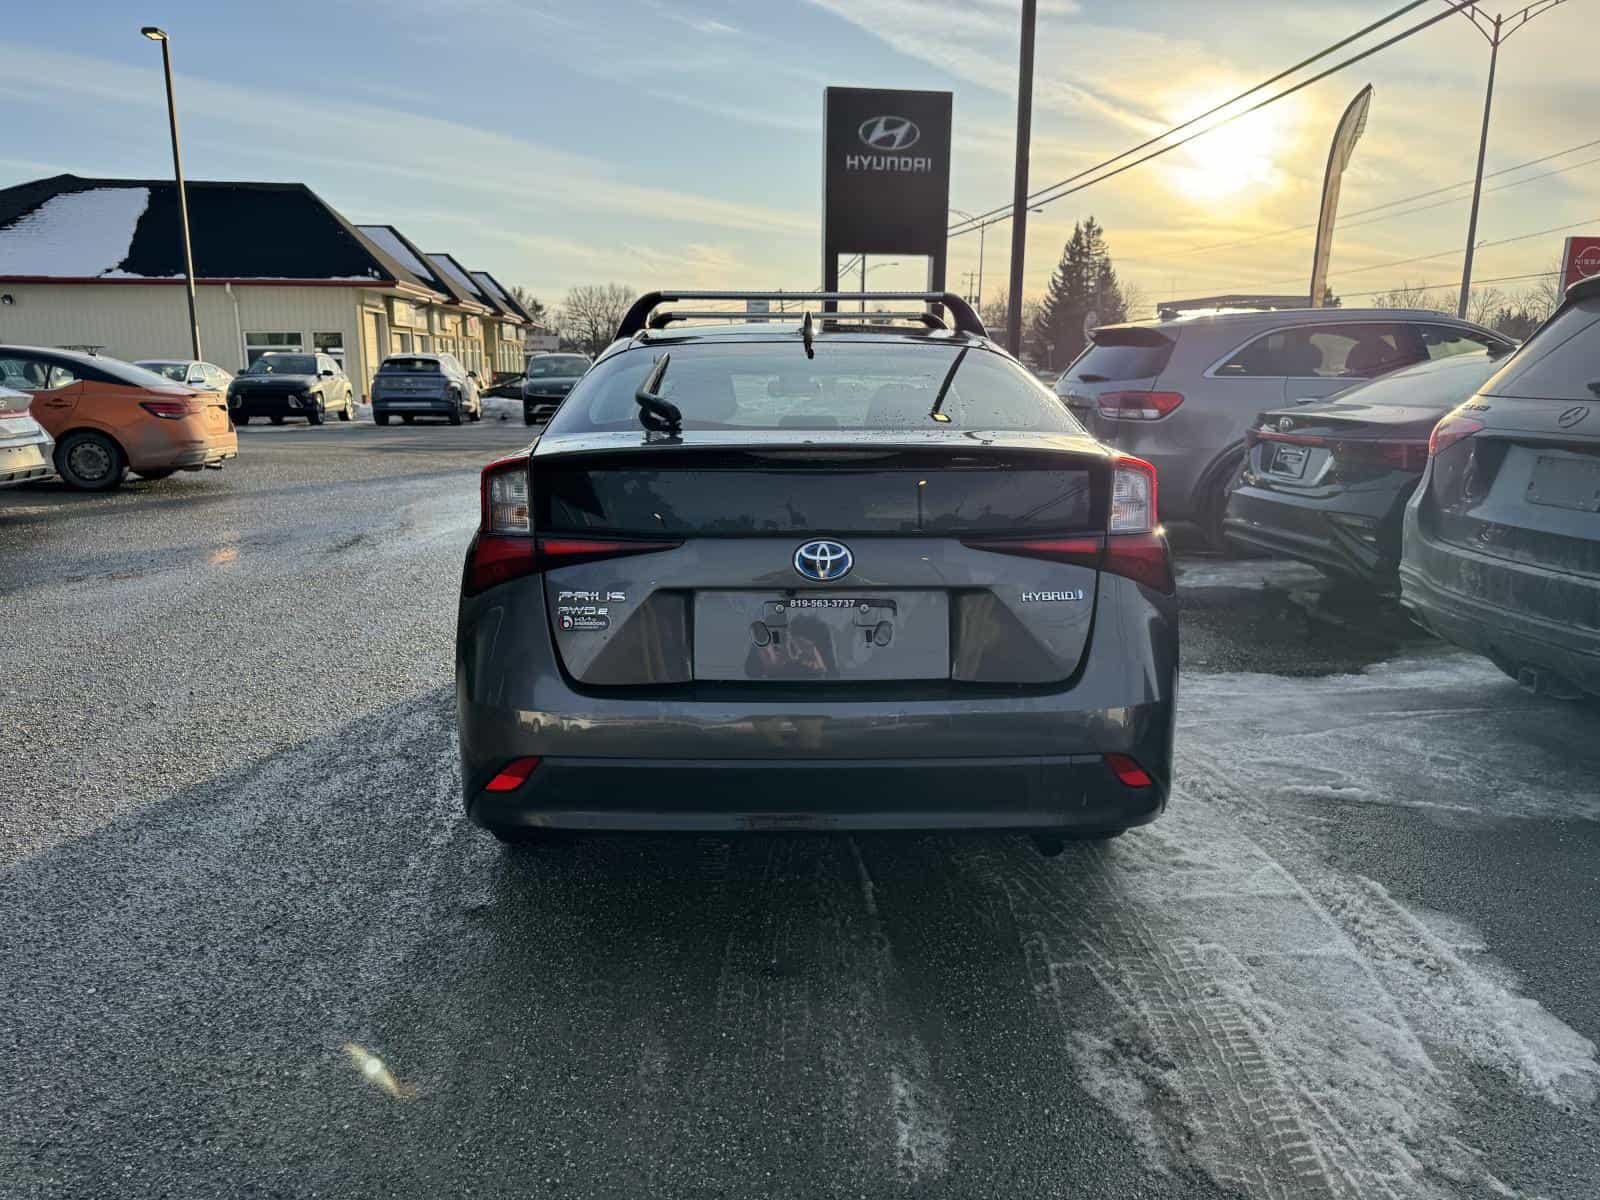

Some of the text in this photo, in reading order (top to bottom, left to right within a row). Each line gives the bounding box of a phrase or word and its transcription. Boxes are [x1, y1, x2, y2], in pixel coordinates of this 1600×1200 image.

[846, 155, 932, 172] HYUNDAI
[558, 591, 626, 602] PRIUS
[1022, 591, 1075, 602] HYBRID
[790, 599, 856, 608] 819-563-3737
